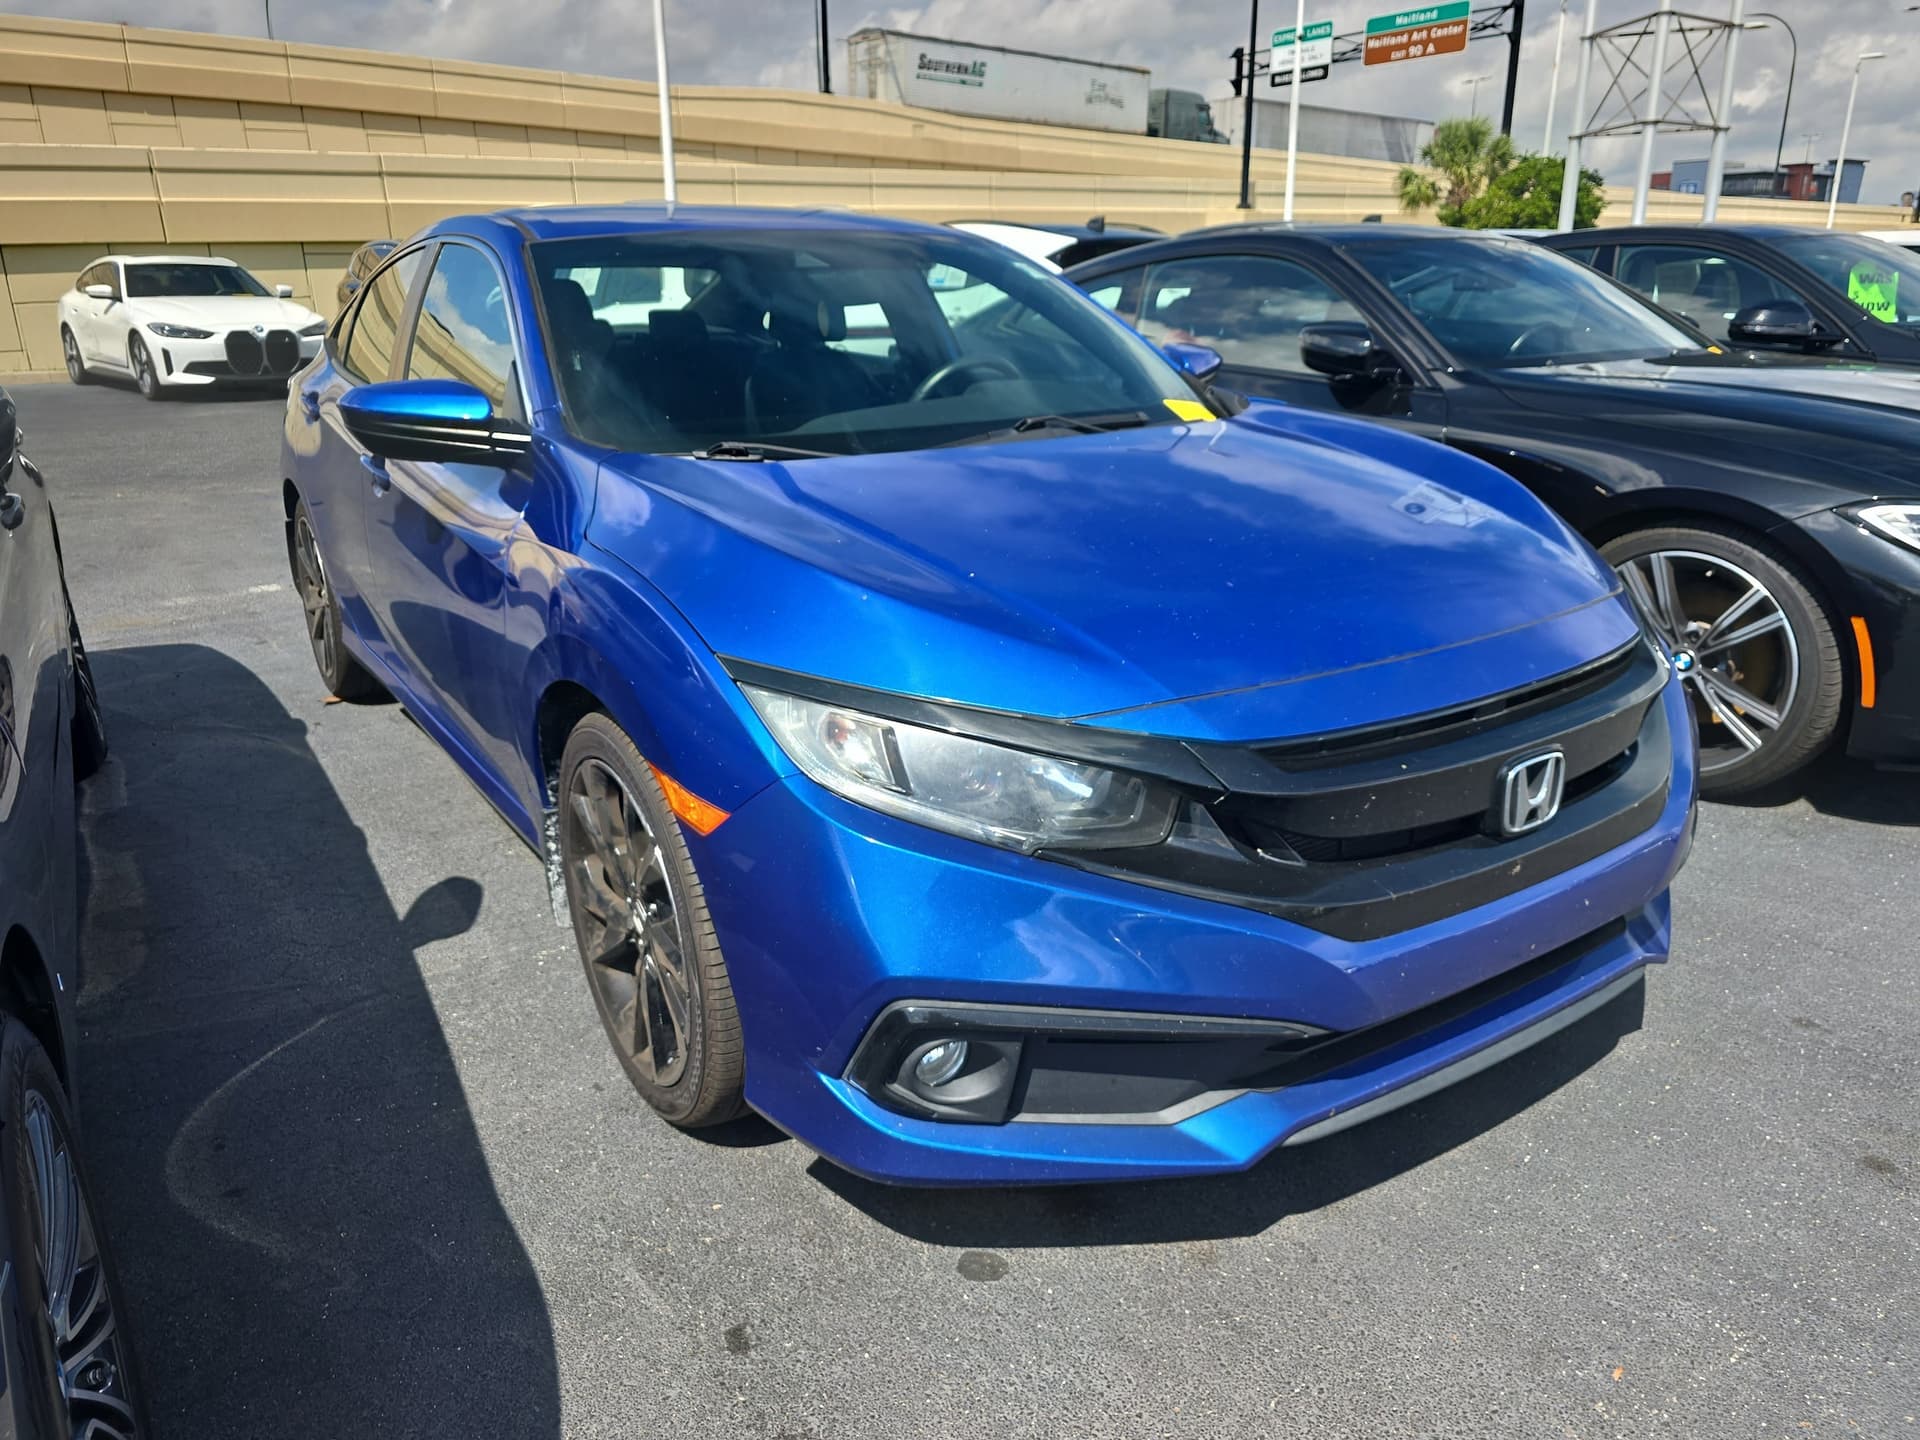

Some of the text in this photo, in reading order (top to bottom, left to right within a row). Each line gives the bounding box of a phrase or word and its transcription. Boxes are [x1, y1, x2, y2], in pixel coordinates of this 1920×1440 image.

[1395, 9, 1438, 26] Maitland
[1367, 24, 1465, 48] Maitland Art Center
[1408, 44, 1423, 57] 90
[1425, 42, 1436, 55] A
[1859, 273, 1892, 284] WAS
